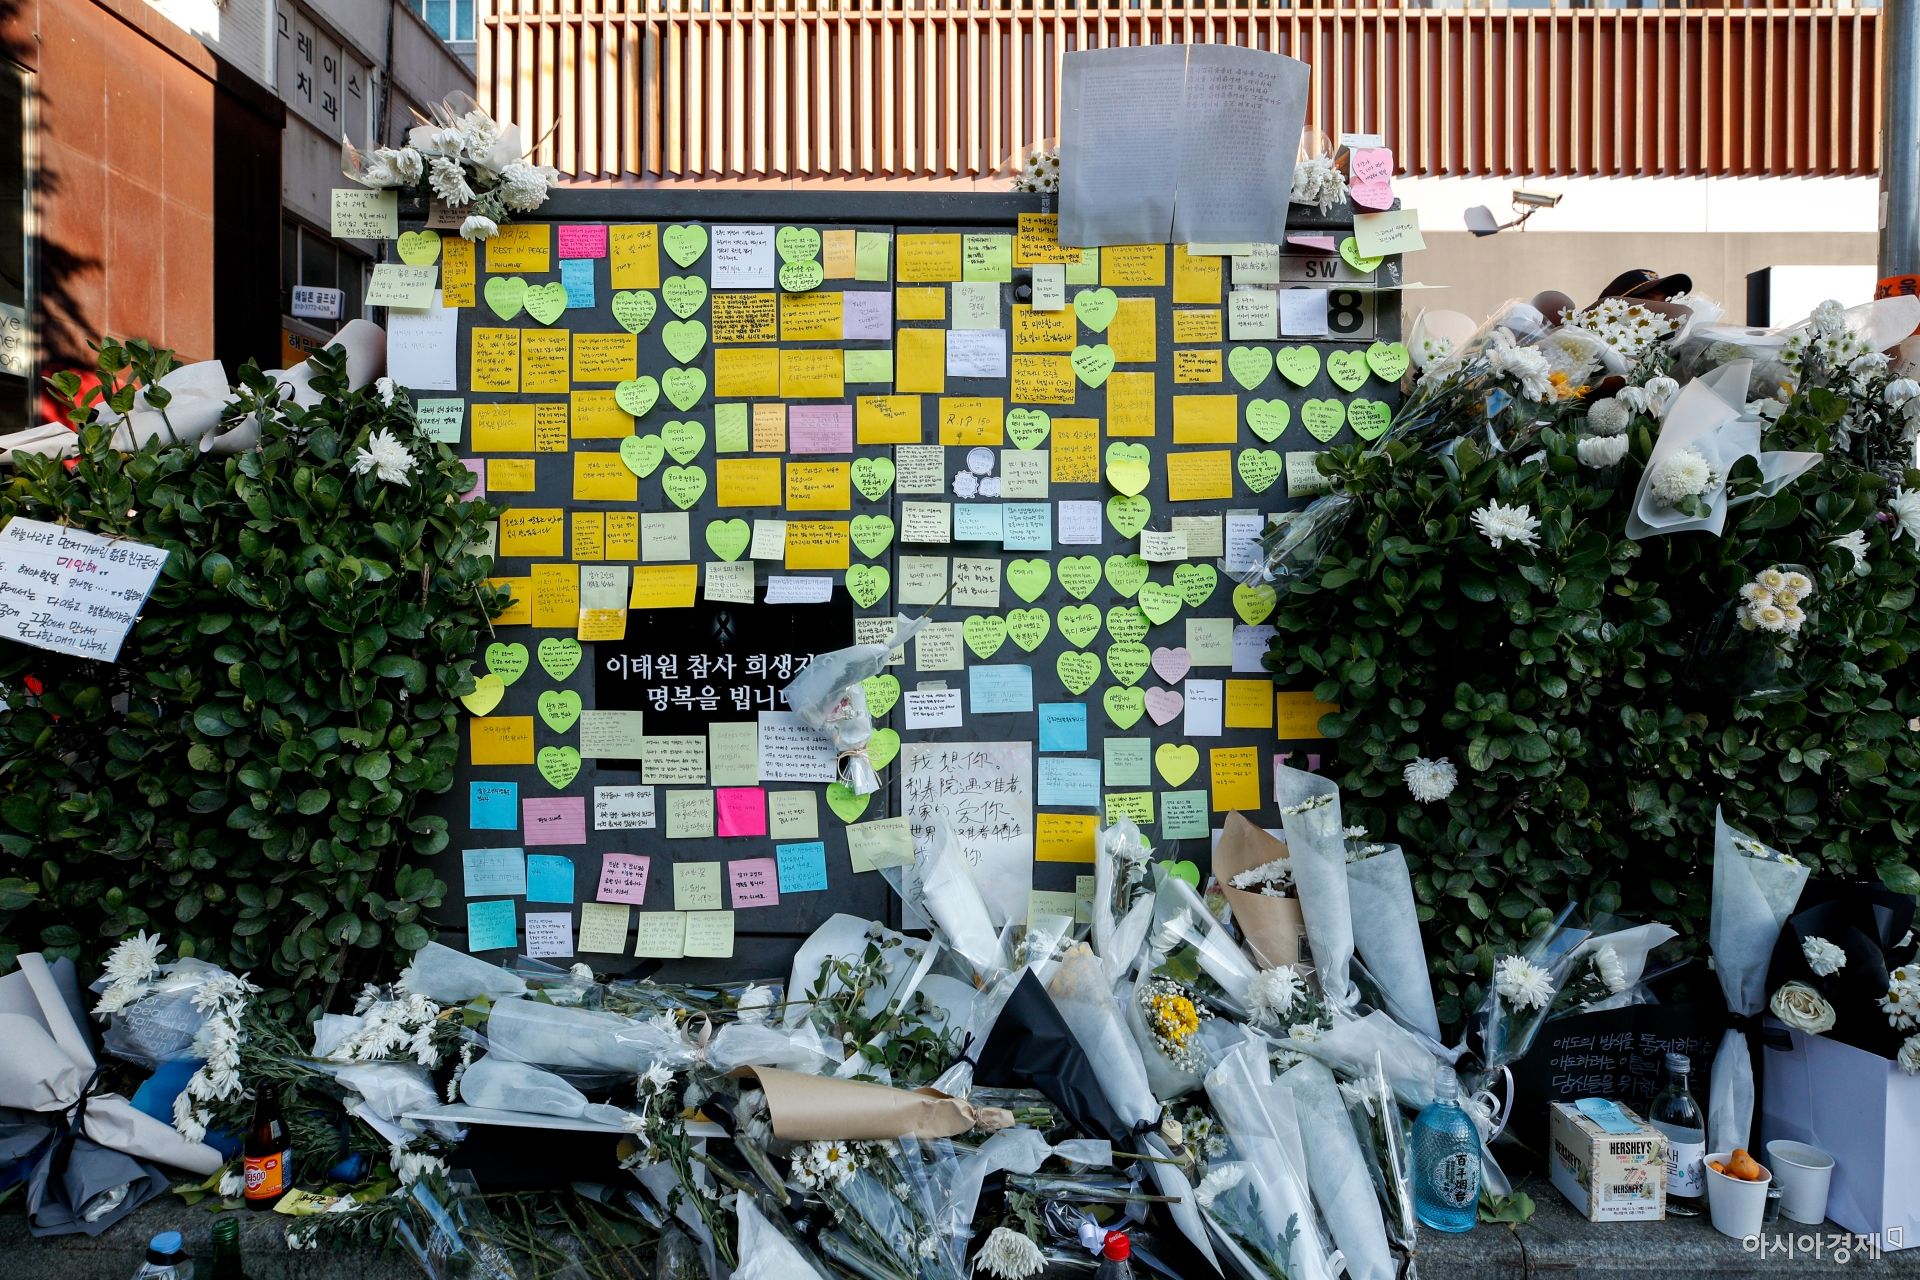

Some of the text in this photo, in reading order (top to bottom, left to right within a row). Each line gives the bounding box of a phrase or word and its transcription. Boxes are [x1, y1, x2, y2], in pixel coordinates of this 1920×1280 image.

[278, 12, 360, 99] 그레이스
[298, 71, 338, 122] 치과
[493, 247, 514, 255] REST
[528, 247, 549, 255] PEACE
[1306, 261, 1338, 278] SW
[11, 527, 55, 546] 하늘나라로
[82, 544, 108, 559] 가버린
[57, 556, 98, 574] 미안해
[606, 654, 679, 681] 이태원
[687, 654, 738, 680] 참사
[647, 685, 786, 712] 명복을 빕니
[910, 751, 1001, 773] 我想你。
[1553, 1035, 1596, 1051] 애도의
[1600, 1032, 1635, 1052] 방식을
[1550, 1054, 1661, 1074] 애도하려는 이들의
[1552, 1073, 1615, 1094] 당신들을
[1610, 1141, 1652, 1156] HERSHEY'S
